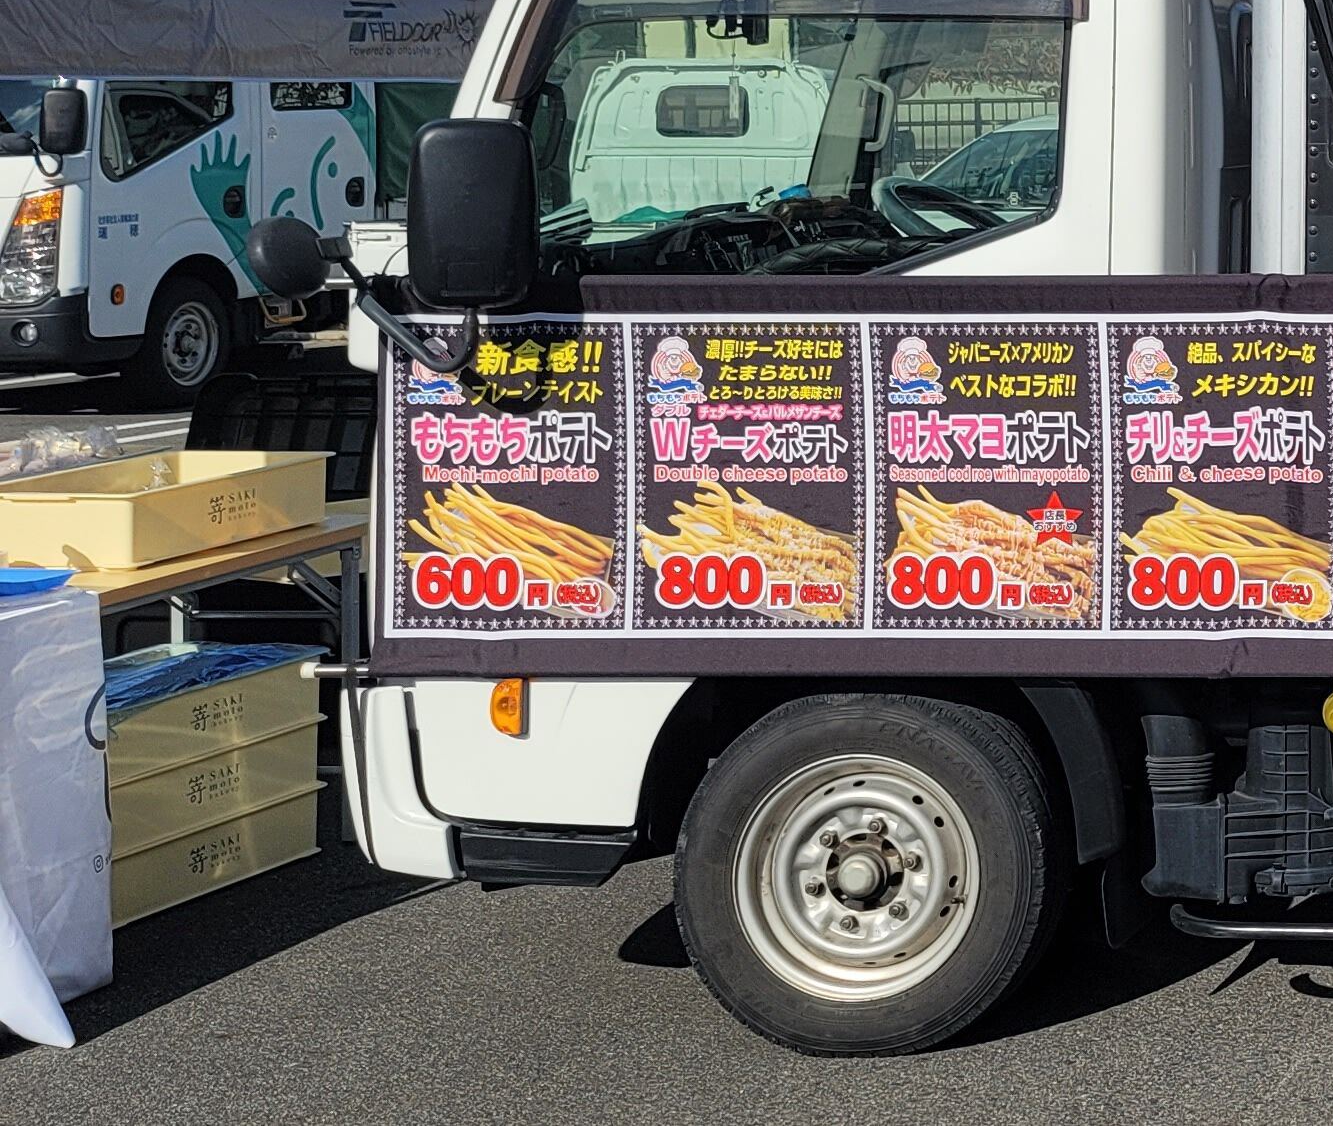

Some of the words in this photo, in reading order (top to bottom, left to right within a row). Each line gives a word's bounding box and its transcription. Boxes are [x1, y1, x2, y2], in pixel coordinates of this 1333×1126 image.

[411, 411, 613, 465] もちもちポテト
[652, 419, 848, 465] Wチーズポテト
[888, 411, 1089, 465] 明太マヨポテト
[1126, 407, 1325, 465] チリ&チーズポテト
[423, 465, 538, 484] Mochi-mochi
[542, 465, 599, 484] potato
[653, 465, 718, 483] Double
[721, 466, 787, 483] cheese
[790, 466, 848, 484] potato
[890, 465, 946, 484] Seasoned
[948, 466, 970, 483] cod
[971, 467, 992, 483] roe
[994, 465, 1019, 483] with
[1131, 465, 1172, 484] Chili
[1179, 465, 1195, 484] &
[1199, 465, 1265, 484] cheese
[1269, 466, 1323, 484] potato
